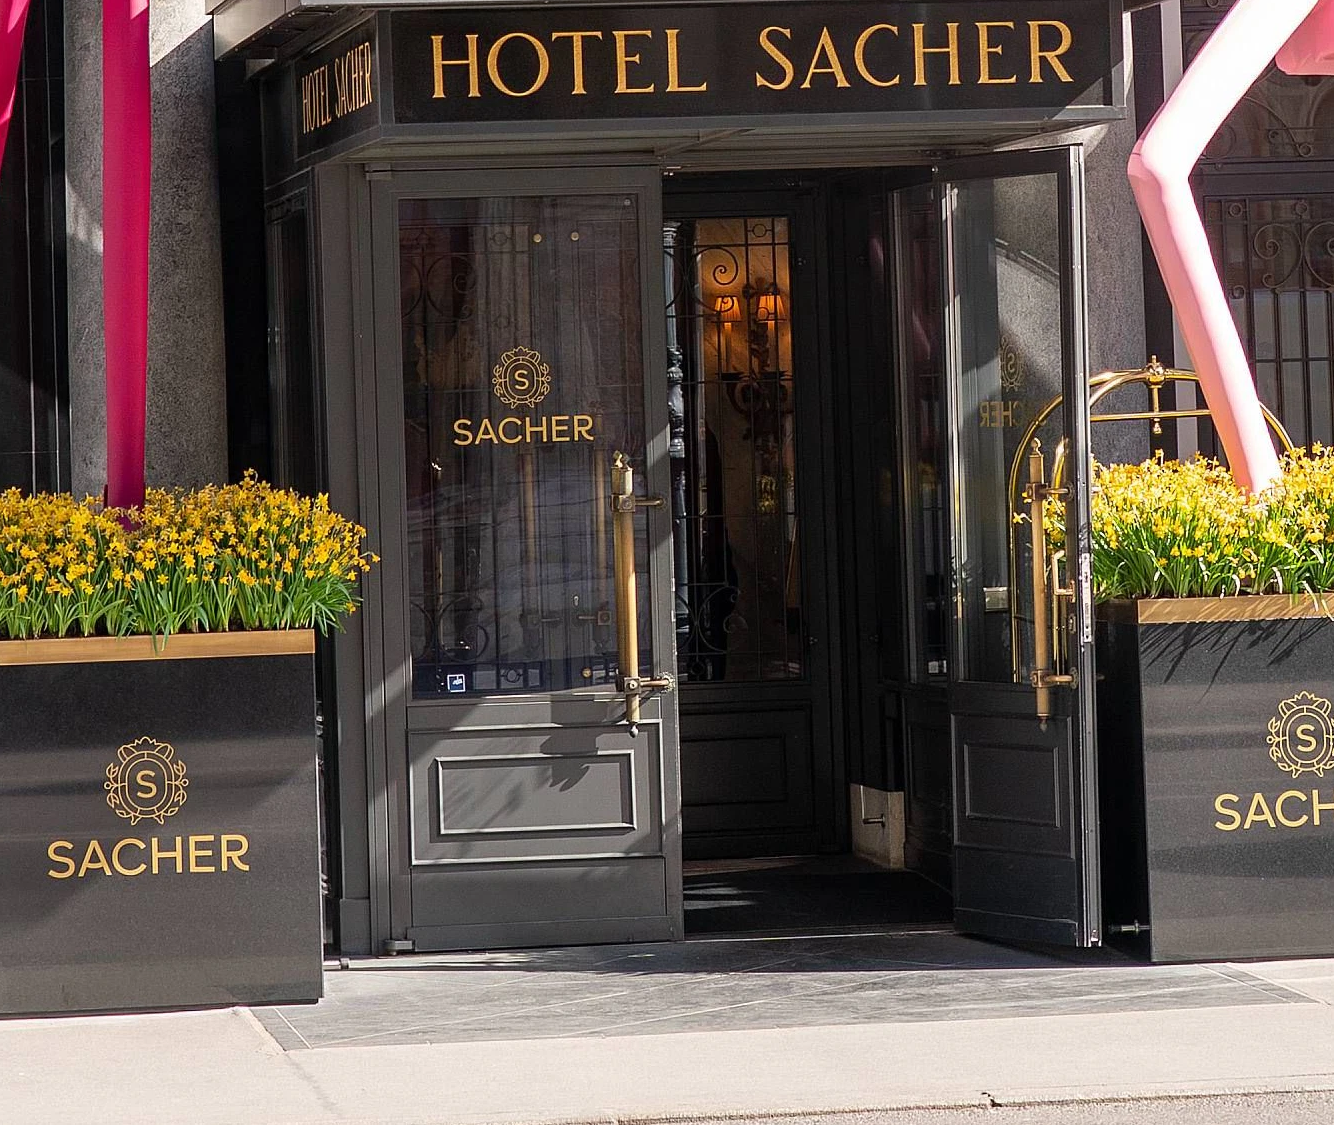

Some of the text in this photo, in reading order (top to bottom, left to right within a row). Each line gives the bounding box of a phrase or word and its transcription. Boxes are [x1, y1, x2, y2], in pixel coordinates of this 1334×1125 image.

[431, 19, 1074, 99] HOTEL SACHER
[301, 41, 372, 134] HOTEL SACHER
[514, 370, 530, 390] S
[453, 414, 595, 446] SACHER
[1296, 724, 1317, 752] S
[136, 770, 158, 799] S
[47, 834, 250, 879] SACHER
